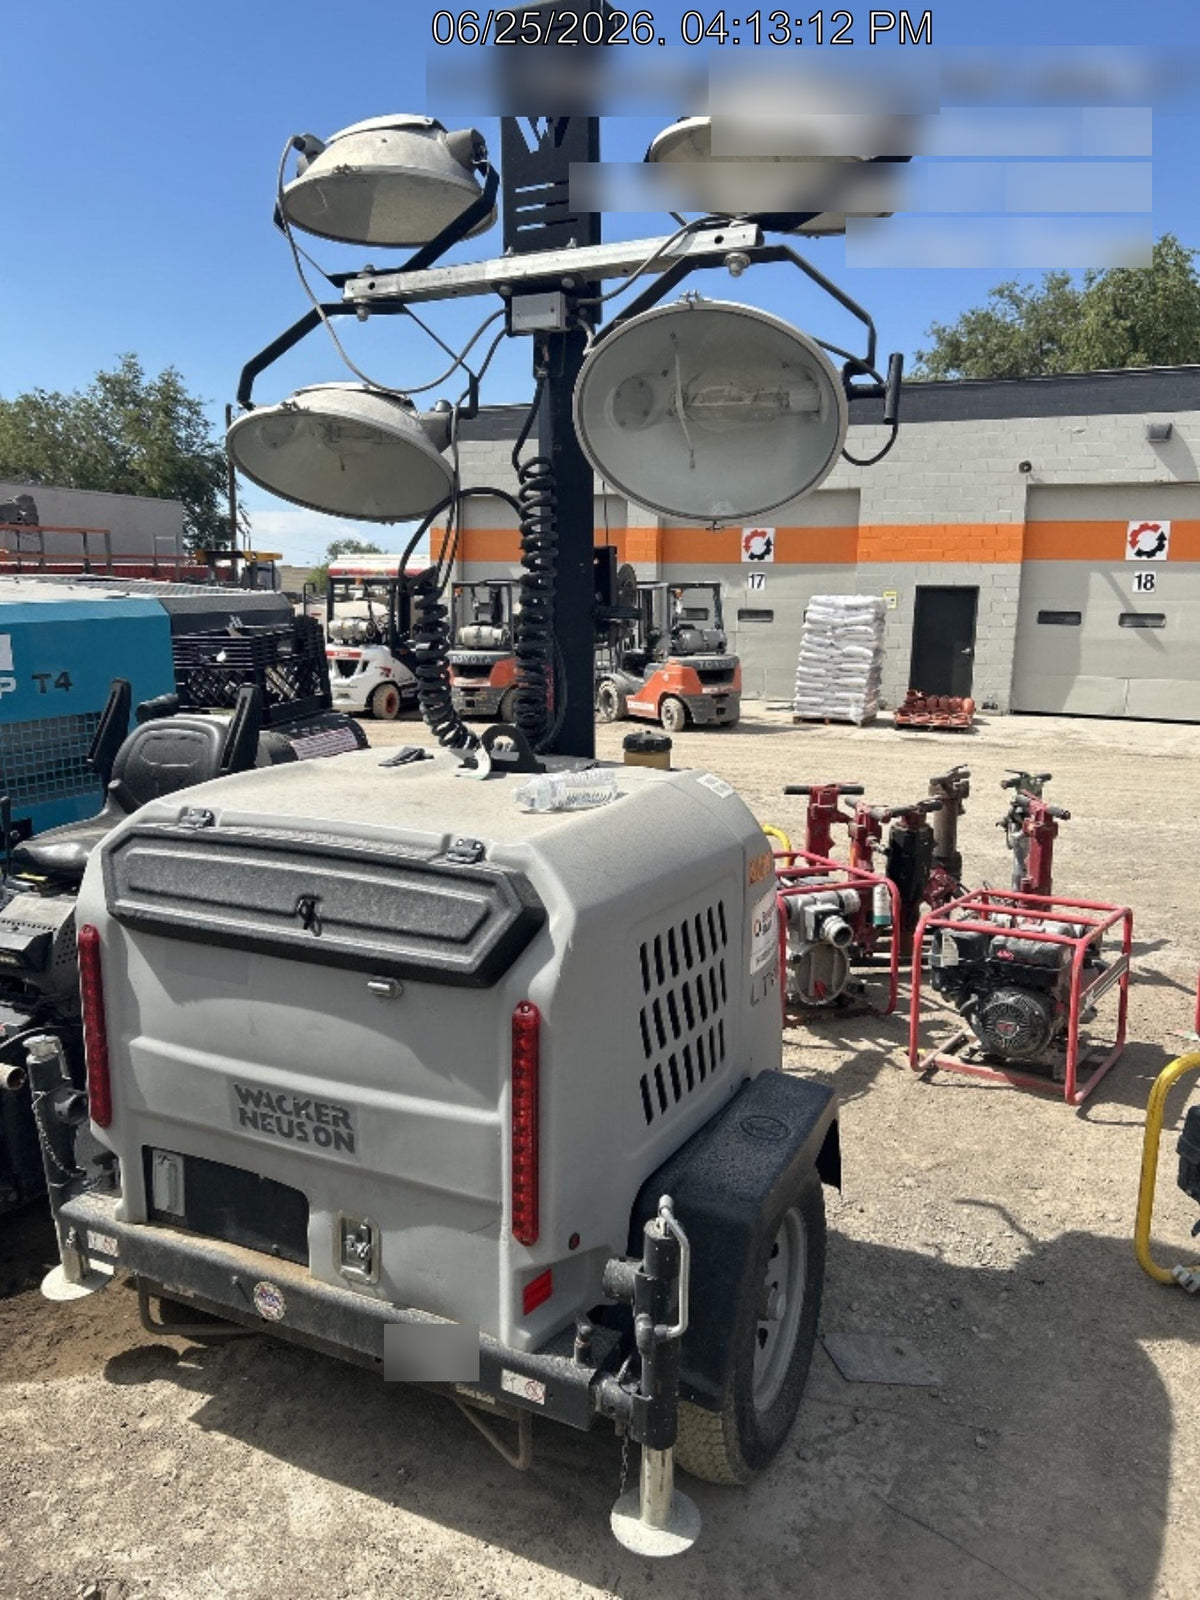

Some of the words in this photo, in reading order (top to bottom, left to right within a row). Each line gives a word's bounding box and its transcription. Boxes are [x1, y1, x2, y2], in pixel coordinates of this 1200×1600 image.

[749, 573, 765, 589] 17
[1134, 573, 1155, 591] 18
[32, 671, 73, 694] T4
[232, 1083, 354, 1131] WACKER
[238, 1106, 356, 1154] NEUSON
